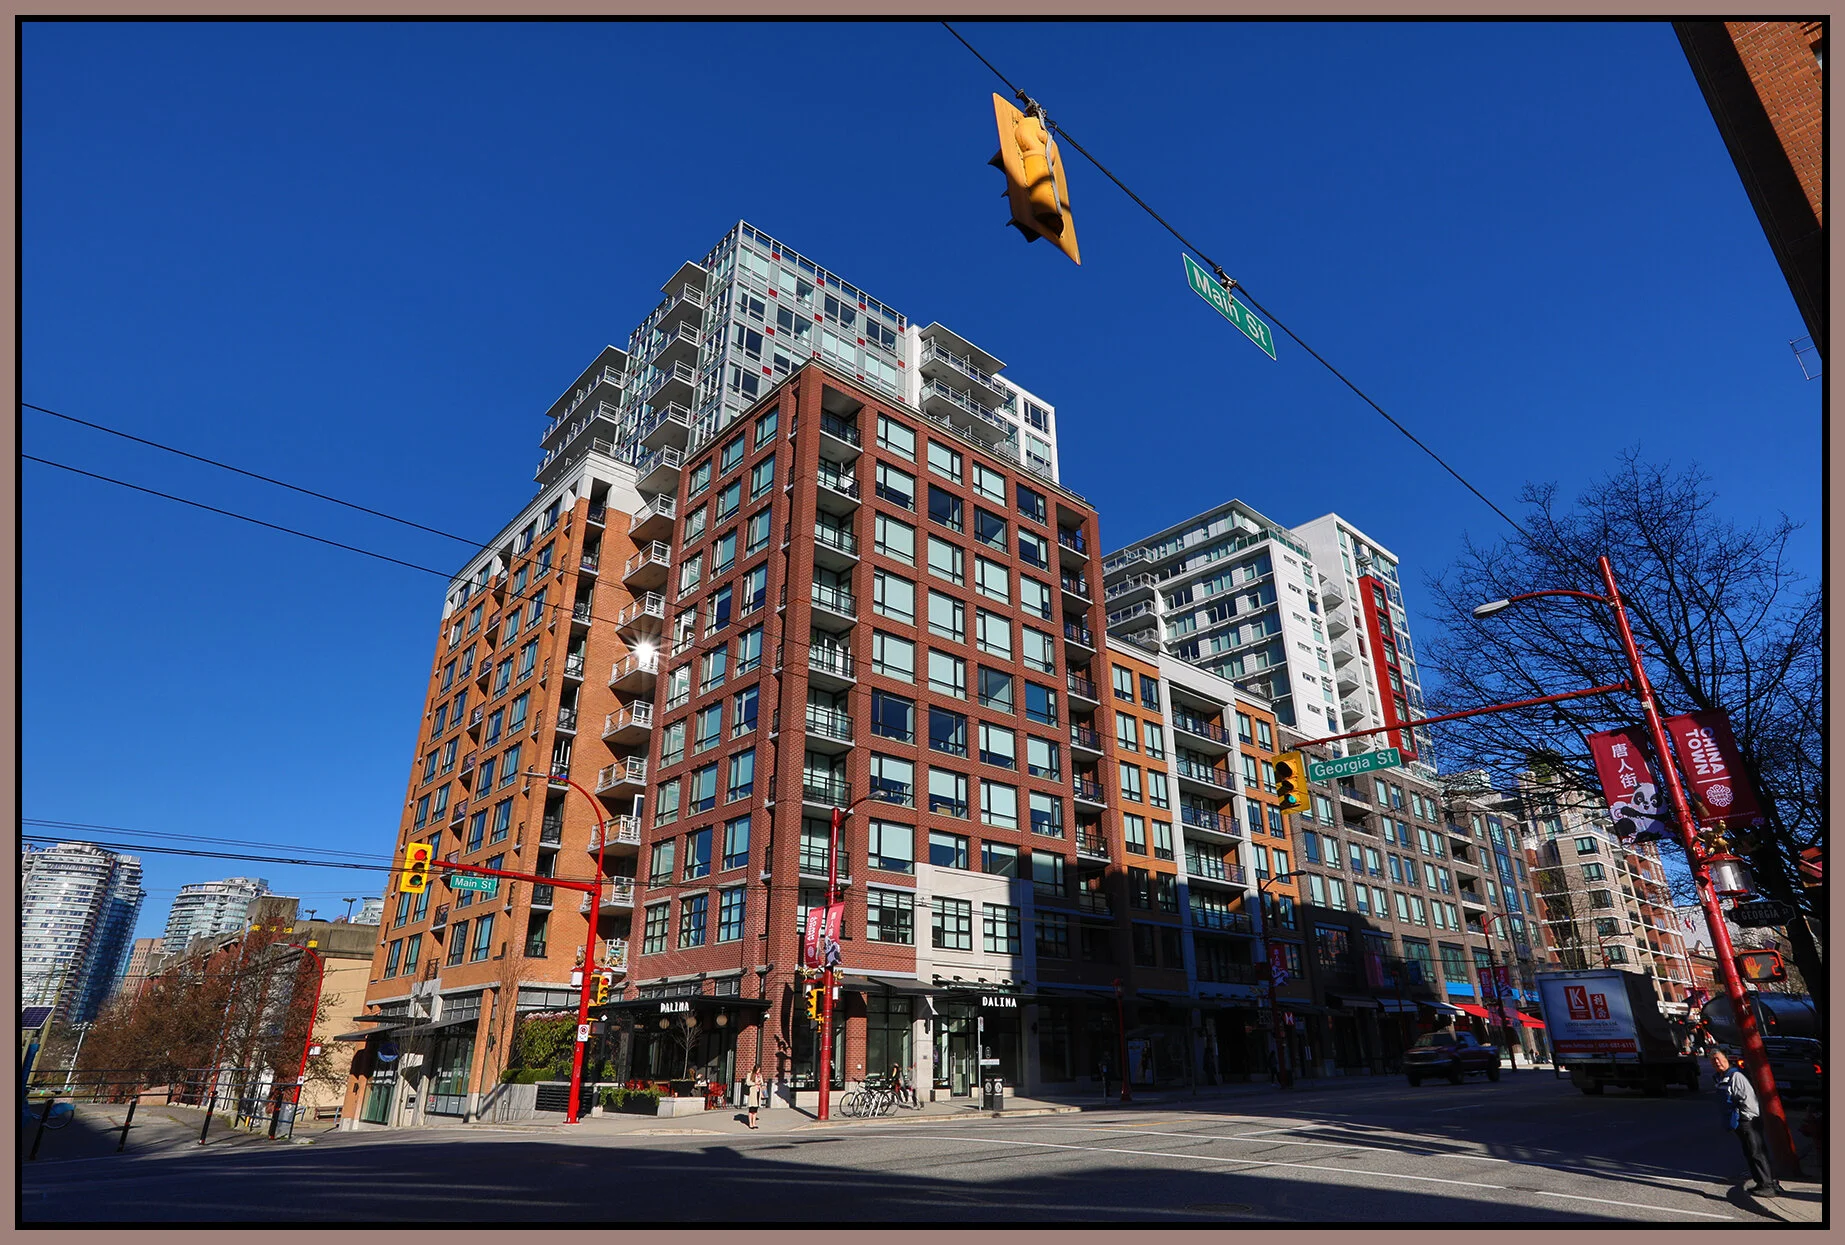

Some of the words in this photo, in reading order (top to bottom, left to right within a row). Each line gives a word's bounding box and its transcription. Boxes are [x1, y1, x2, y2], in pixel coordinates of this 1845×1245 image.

[1193, 266, 1240, 323] Main
[1245, 313, 1267, 347] St
[1685, 728, 1711, 776] TOWN
[1700, 726, 1726, 775] CHINA
[1314, 757, 1370, 777] Georgia
[1376, 751, 1394, 765] St
[1611, 743, 1639, 789] 唐人街
[454, 877, 477, 888] Main
[481, 880, 492, 890] St
[1741, 909, 1780, 920] GEORGIA
[1769, 955, 1782, 976] 2
[660, 1001, 690, 1013] DALINA
[982, 996, 1017, 1008] DALINA
